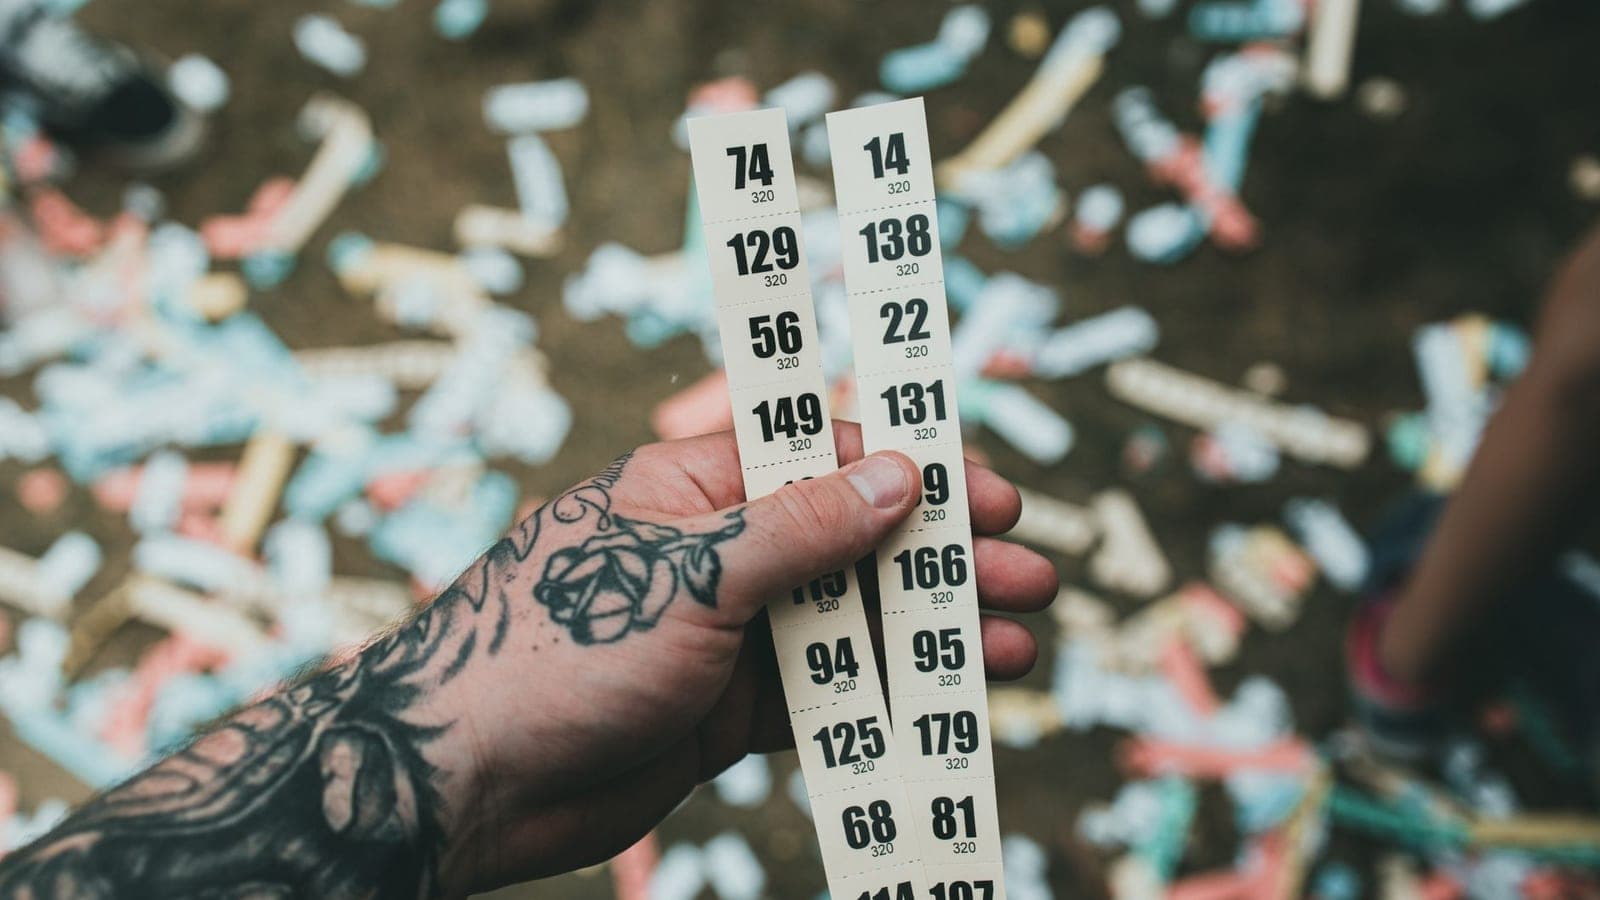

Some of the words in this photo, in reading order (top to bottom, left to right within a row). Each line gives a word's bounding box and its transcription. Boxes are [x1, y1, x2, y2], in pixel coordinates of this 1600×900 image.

[864, 133, 910, 179] 14
[727, 143, 774, 190] 74
[888, 181, 911, 194] 320
[752, 190, 775, 203] 320
[859, 214, 932, 263] 138
[727, 226, 800, 276] 129
[896, 263, 919, 277] 320
[765, 274, 788, 287] 320
[880, 298, 931, 345] 22
[749, 311, 803, 359] 56
[905, 345, 928, 358] 320
[777, 357, 799, 370] 320
[880, 379, 947, 427] 131
[752, 392, 823, 443] 149
[914, 428, 937, 441] 320
[789, 438, 812, 452] 320
[914, 463, 950, 508] 9
[923, 509, 946, 522] 320
[893, 543, 967, 591] 166
[931, 591, 954, 604] 320
[817, 599, 839, 613] 320
[913, 627, 966, 673] 95
[806, 636, 859, 685] 94
[834, 679, 856, 693] 320
[938, 675, 961, 687] 320
[912, 710, 979, 756] 179
[812, 715, 886, 769] 125
[852, 760, 875, 775] 320
[946, 757, 968, 770] 320
[842, 799, 897, 850] 68
[931, 795, 977, 841] 81
[871, 843, 894, 857] 320
[953, 842, 976, 854] 320
